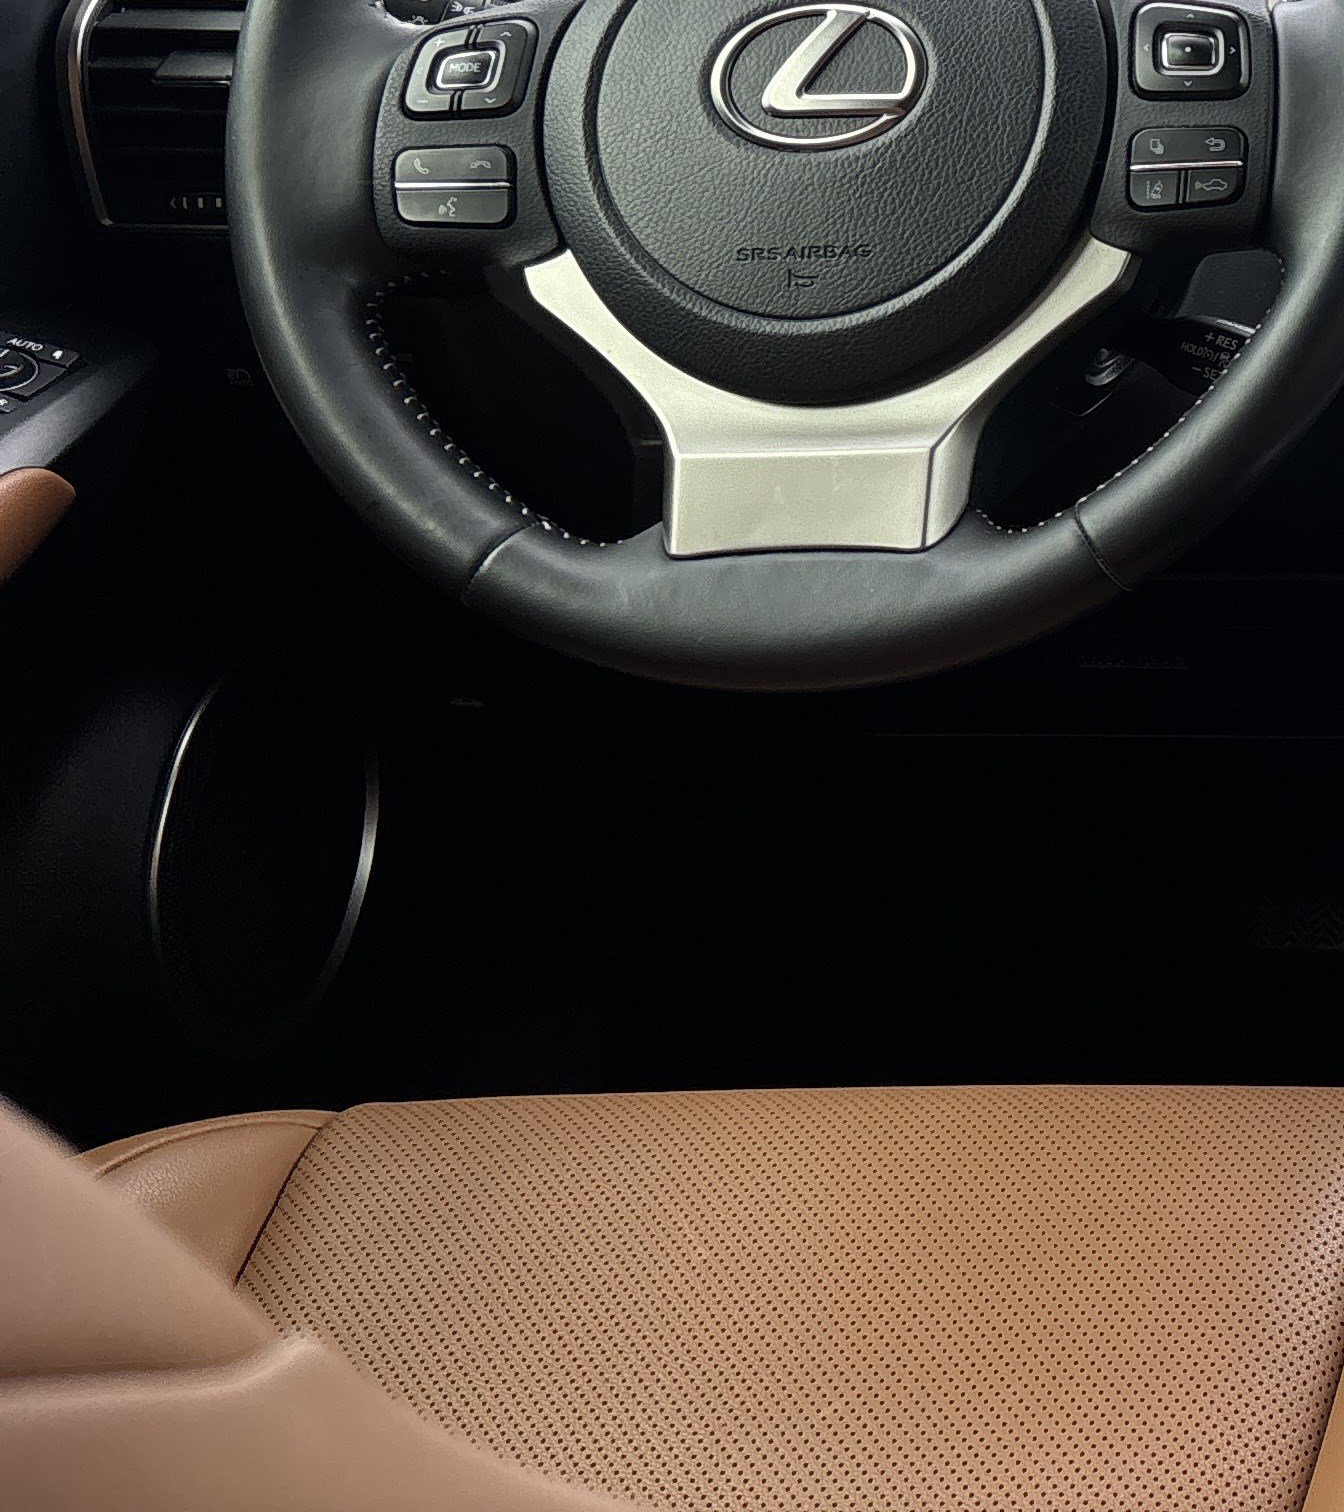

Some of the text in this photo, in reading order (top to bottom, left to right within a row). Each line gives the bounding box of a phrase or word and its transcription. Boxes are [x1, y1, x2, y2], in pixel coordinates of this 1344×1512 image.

[449, 62, 481, 73] MODE
[736, 244, 872, 261] SRS AIRBAG
[6, 337, 44, 351] AUTO
[1215, 334, 1239, 351] RES
